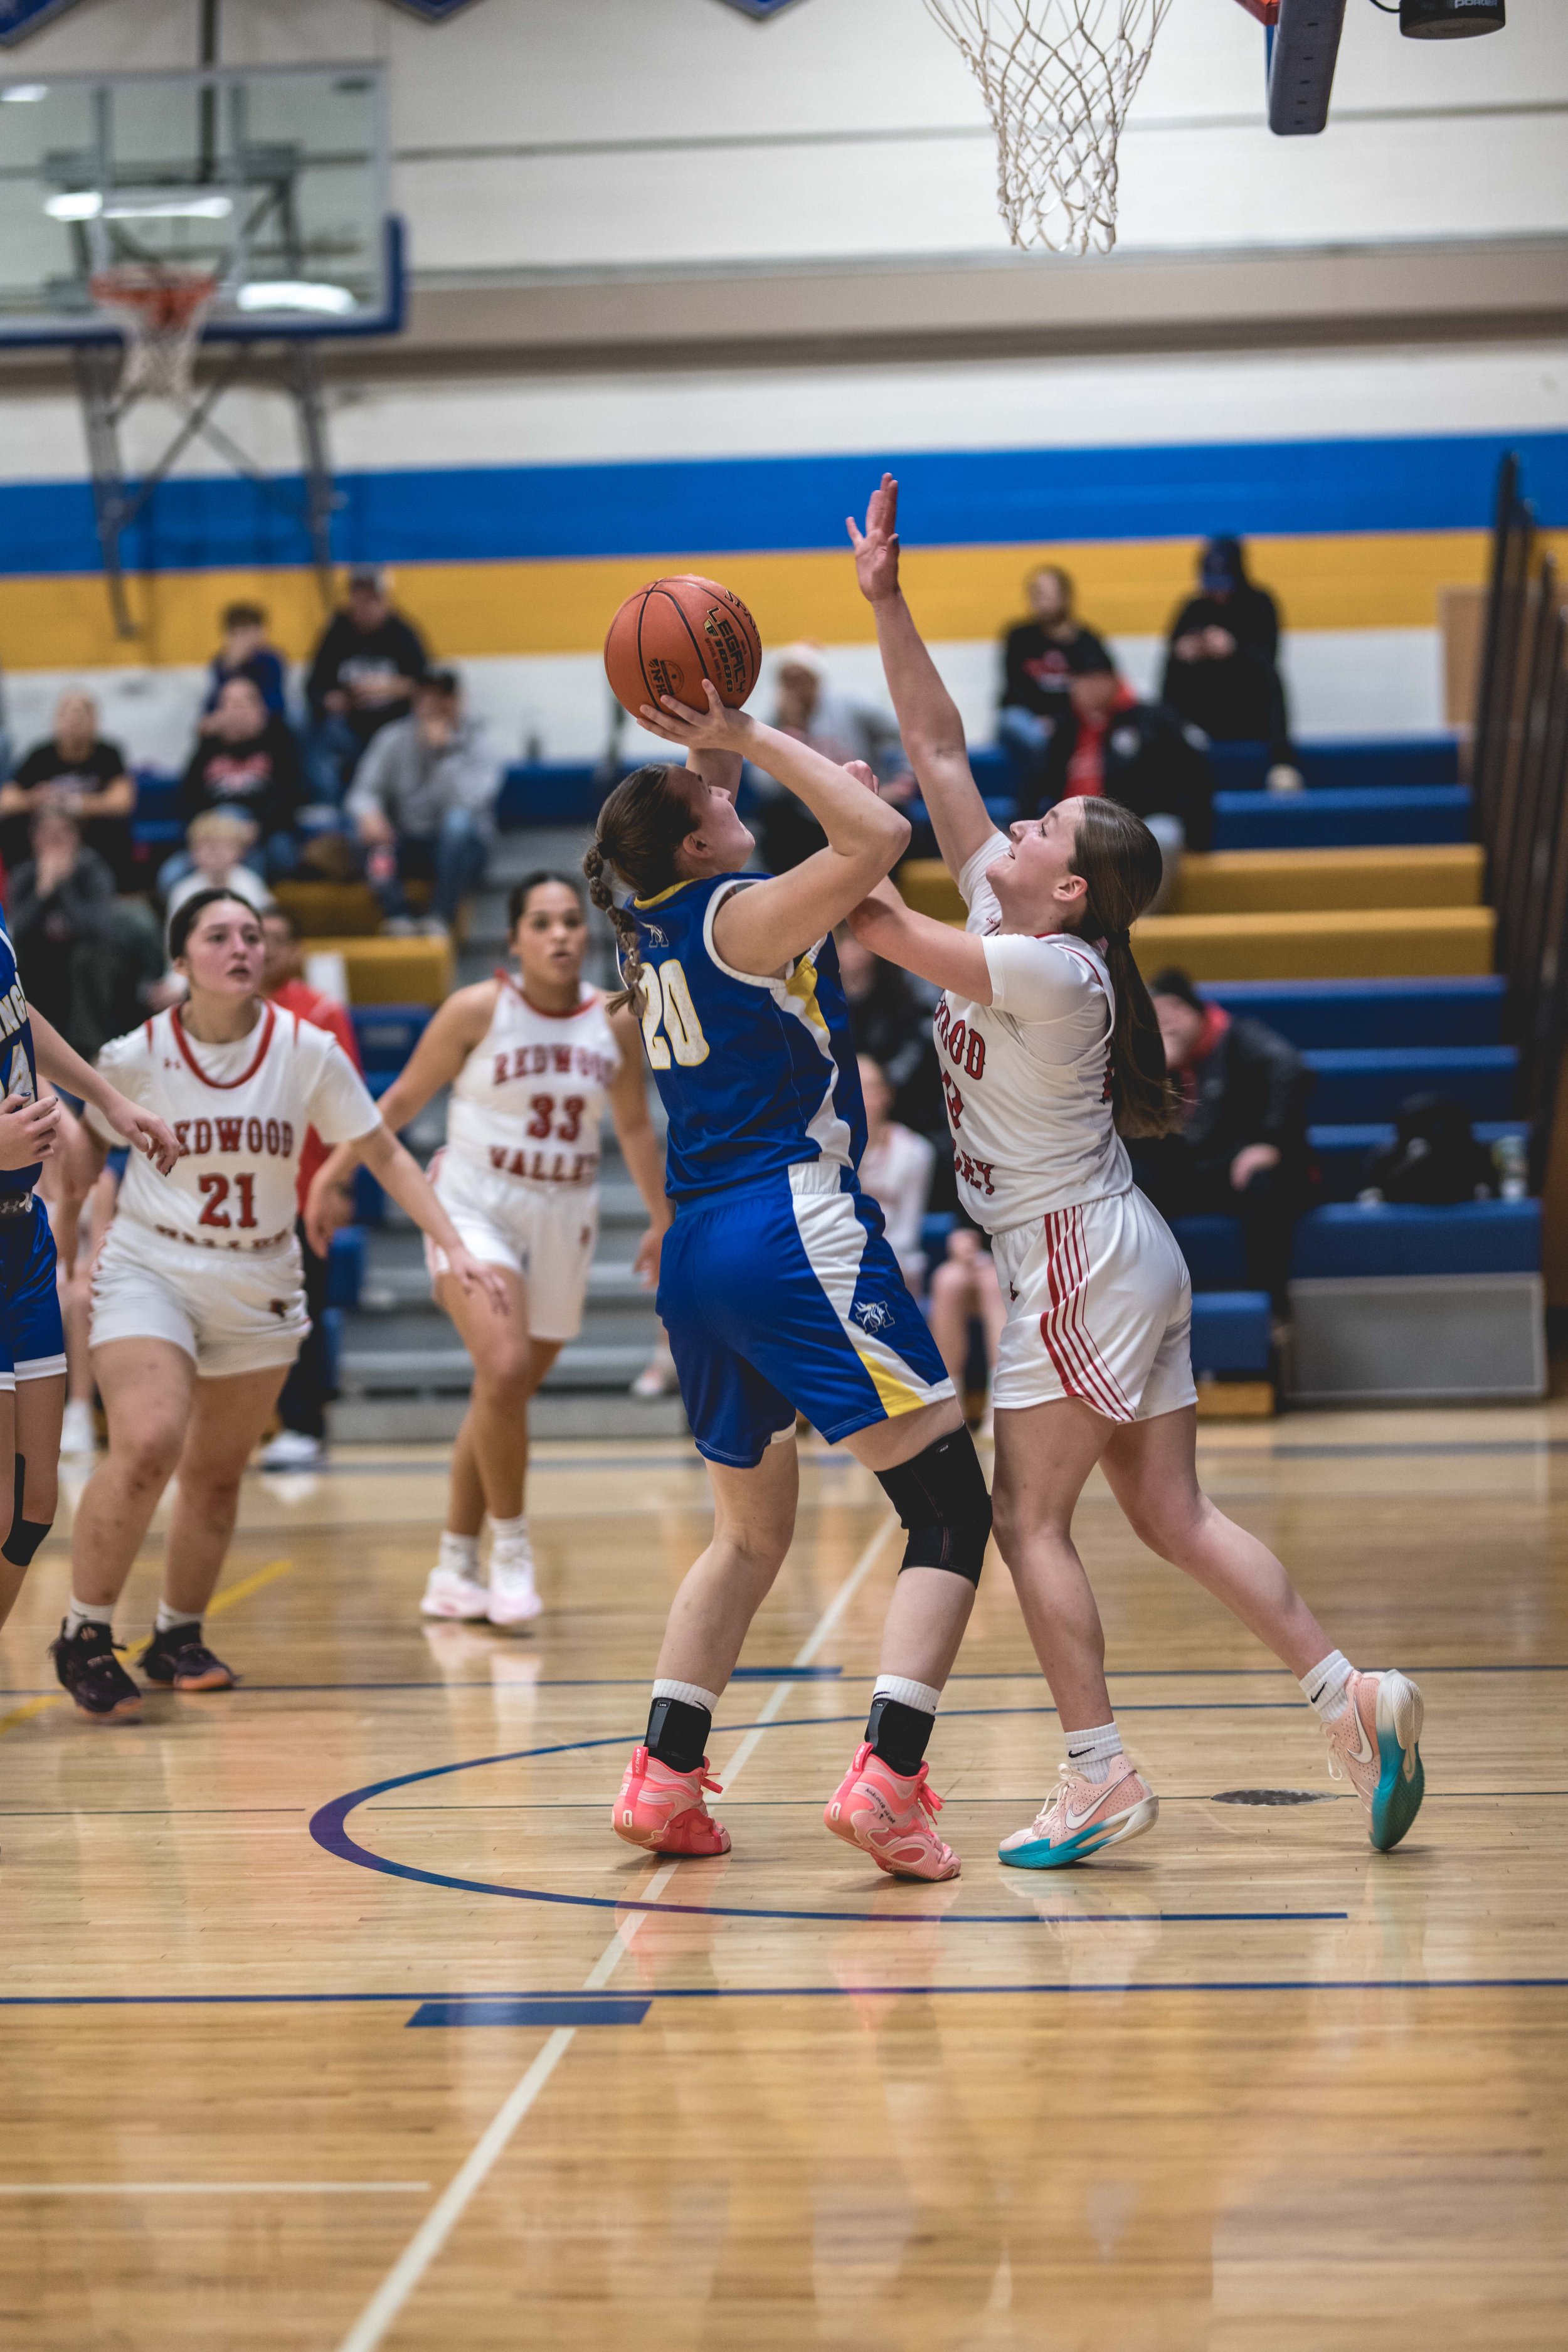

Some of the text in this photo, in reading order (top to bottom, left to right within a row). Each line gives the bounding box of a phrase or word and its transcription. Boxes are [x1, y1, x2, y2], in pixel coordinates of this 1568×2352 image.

[707, 607, 746, 693] LEGACY
[638, 958, 710, 1070] 20
[174, 1116, 294, 1158] EDWOOD
[526, 1093, 586, 1142] 33
[198, 1172, 258, 1228] 21
